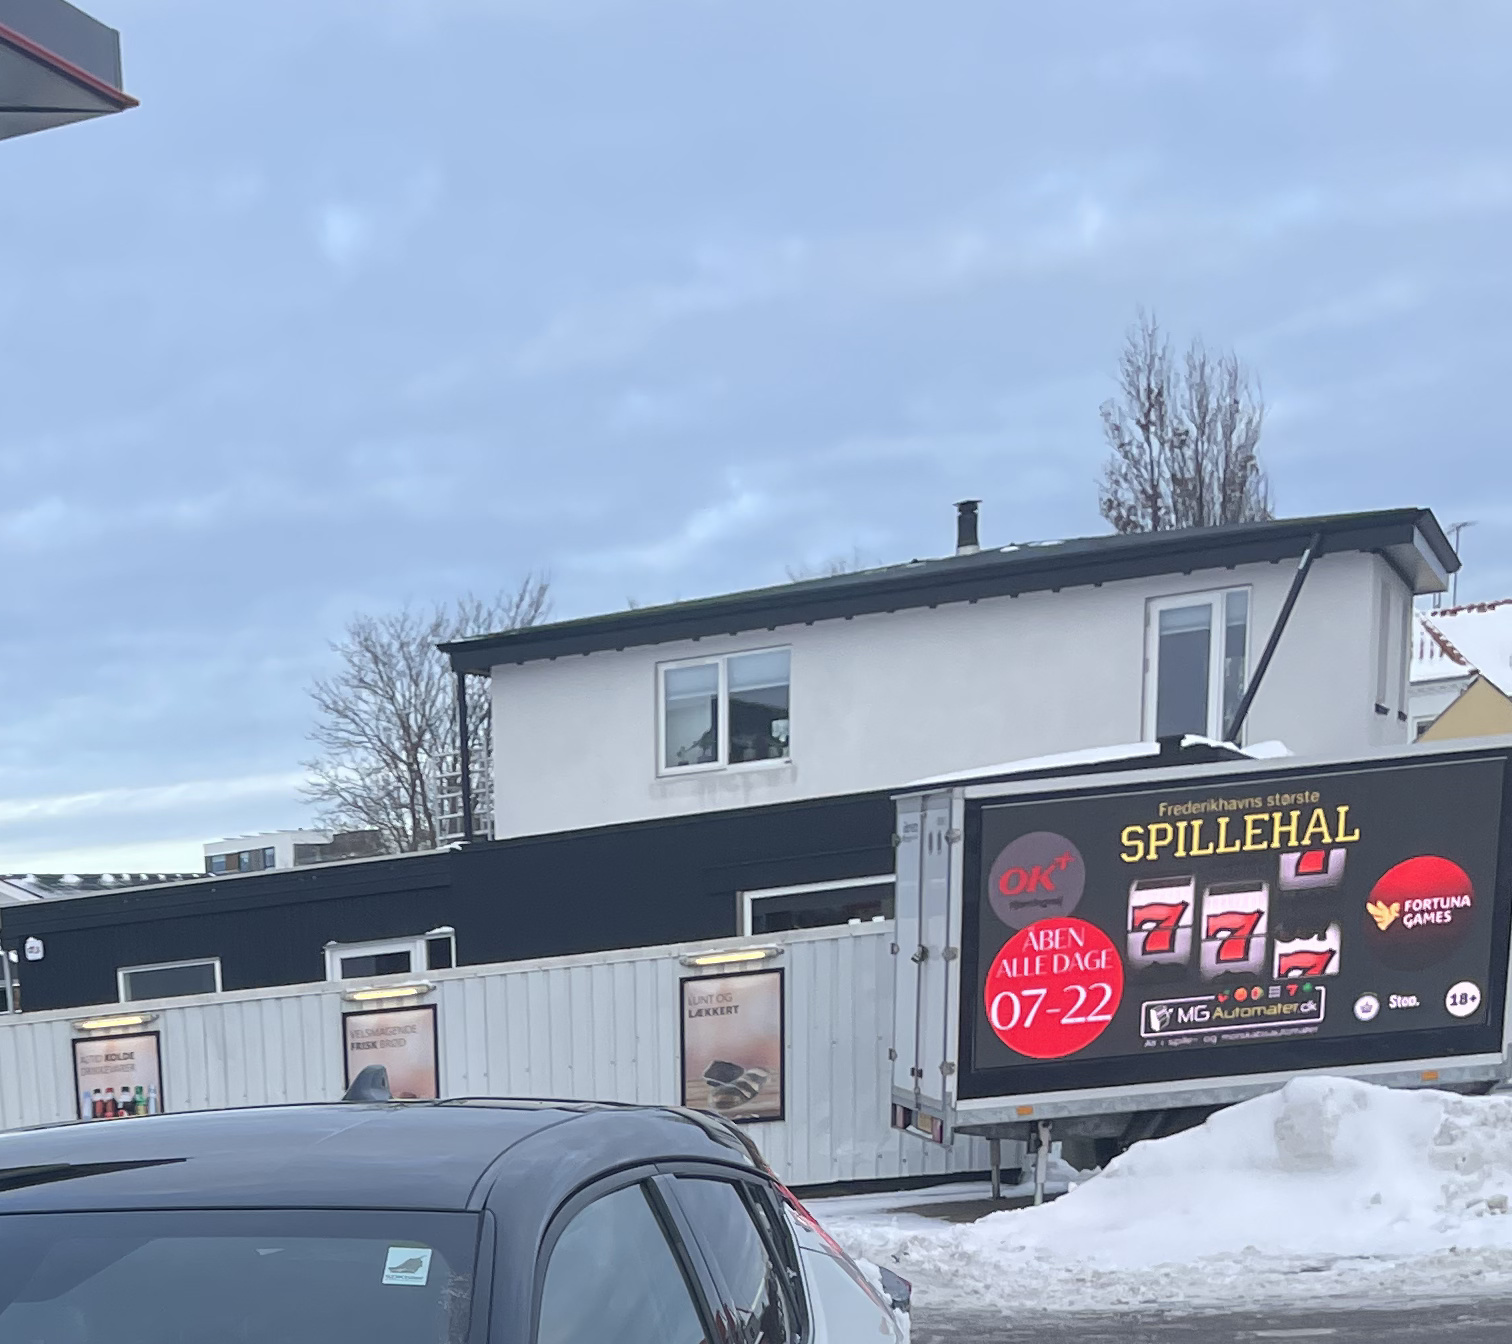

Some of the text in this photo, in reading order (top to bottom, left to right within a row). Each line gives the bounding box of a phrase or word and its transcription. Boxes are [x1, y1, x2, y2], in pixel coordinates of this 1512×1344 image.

[1158, 790, 1321, 817] Frederikhavns største
[1120, 805, 1361, 863] SPILLEHAL
[1404, 894, 1472, 912] FORTUNA
[1403, 910, 1452, 929] GAMES
[1022, 925, 1085, 952] ÅBEN
[995, 949, 1114, 979] ALLE DAGE
[688, 992, 733, 1006] LUNT OG
[990, 982, 1113, 1031] 07-22
[1449, 993, 1477, 1007] 18+
[688, 1004, 740, 1019] LÆKKERT
[1177, 1004, 1210, 1024] MG
